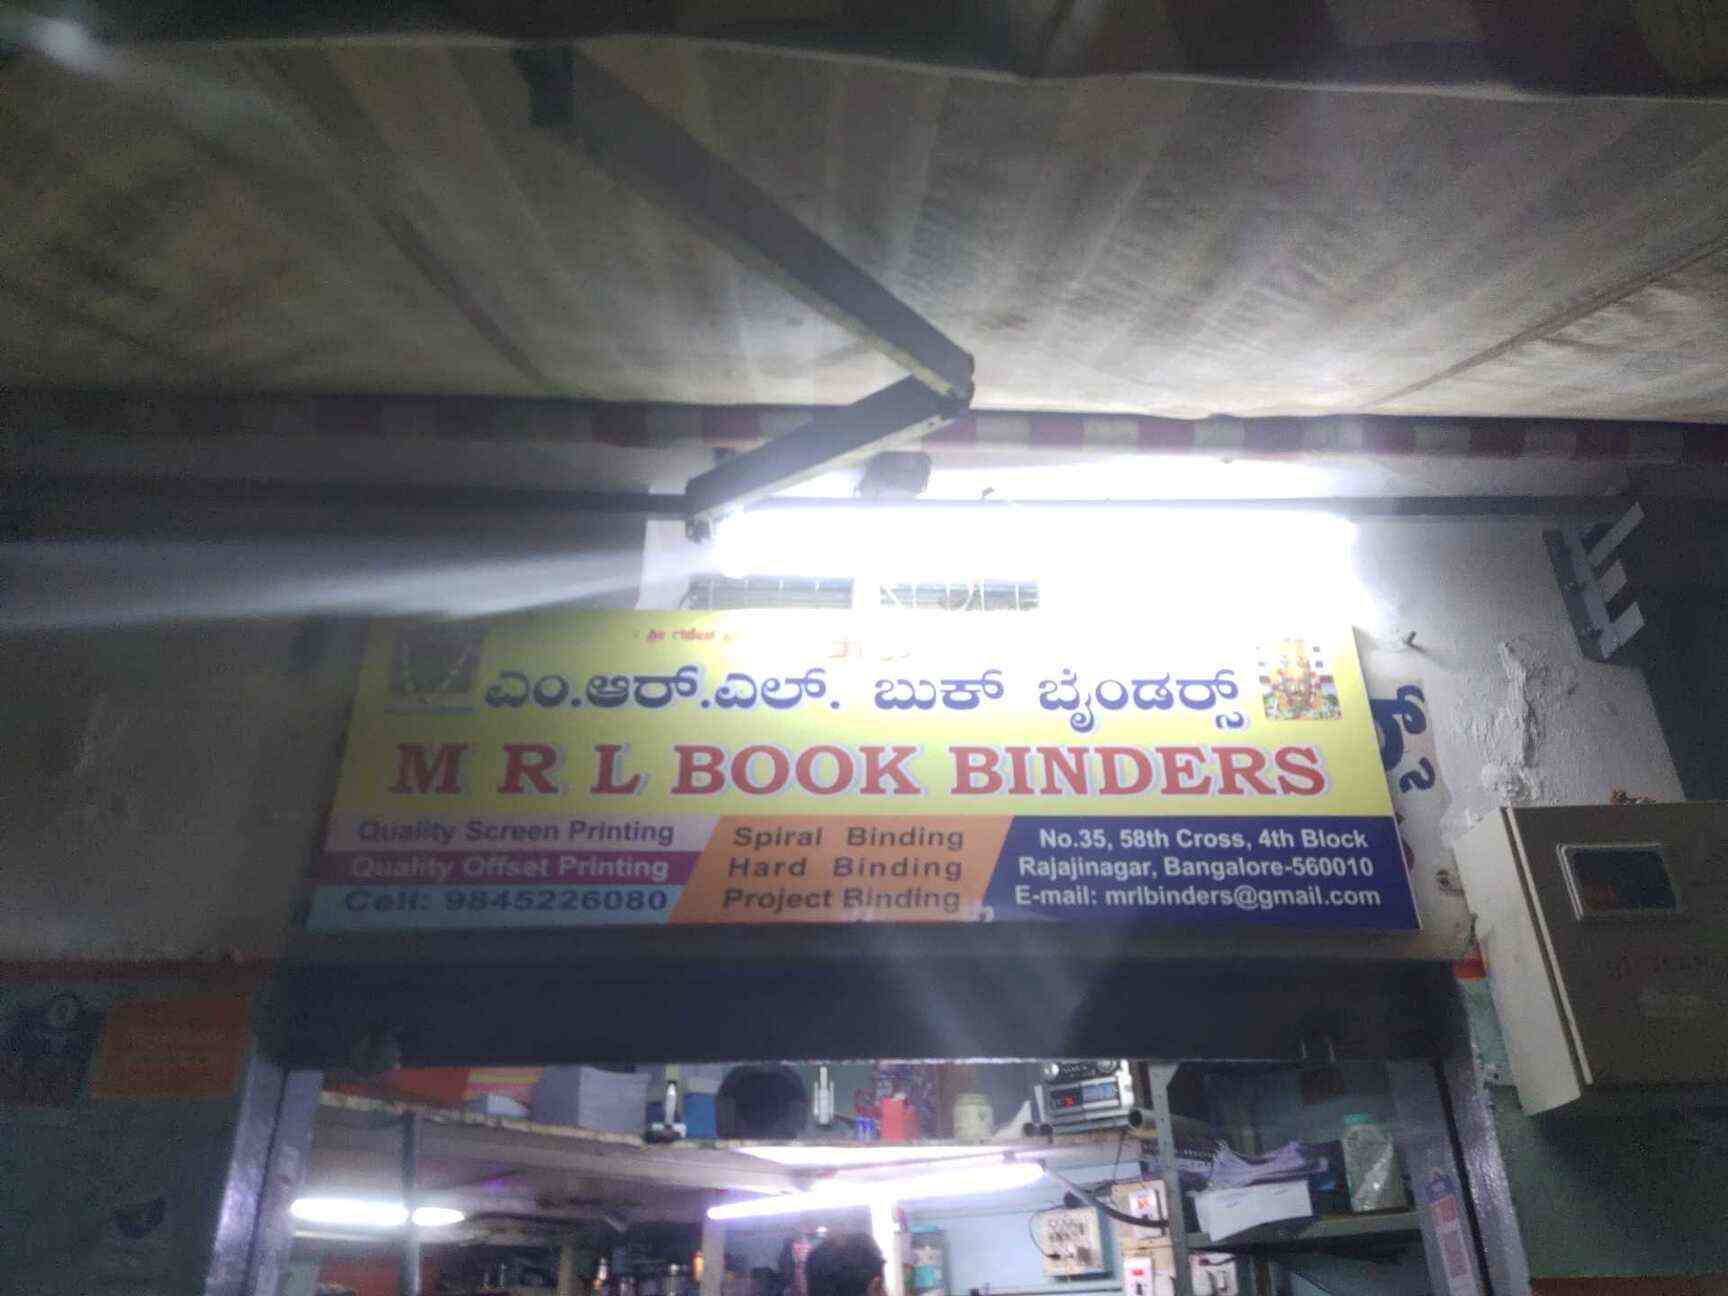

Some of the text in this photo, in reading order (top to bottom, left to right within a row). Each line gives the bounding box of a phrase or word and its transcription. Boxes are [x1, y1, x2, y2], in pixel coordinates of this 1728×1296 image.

[874, 668, 1004, 710] ಬುಕ್
[1038, 667, 1245, 734] ಬೈಂಡರ್ಸ್
[388, 742, 1326, 796] M R L BOOK BINDERS
[357, 819, 675, 846] Quality Screen Printing
[732, 827, 964, 850] Spiral Binding
[1039, 828, 1369, 850] No.35, 58th Cross, 4th Block
[350, 854, 671, 882] Quality Offset Printing
[727, 857, 962, 881] Hard Binding
[1018, 856, 1375, 880] Rajajinagar, Bangalore-560010
[445, 888, 669, 912] 9845226080
[723, 887, 961, 914] Project Binding
[1014, 884, 1382, 909] E-mail: mrlbinders@gmail.com
